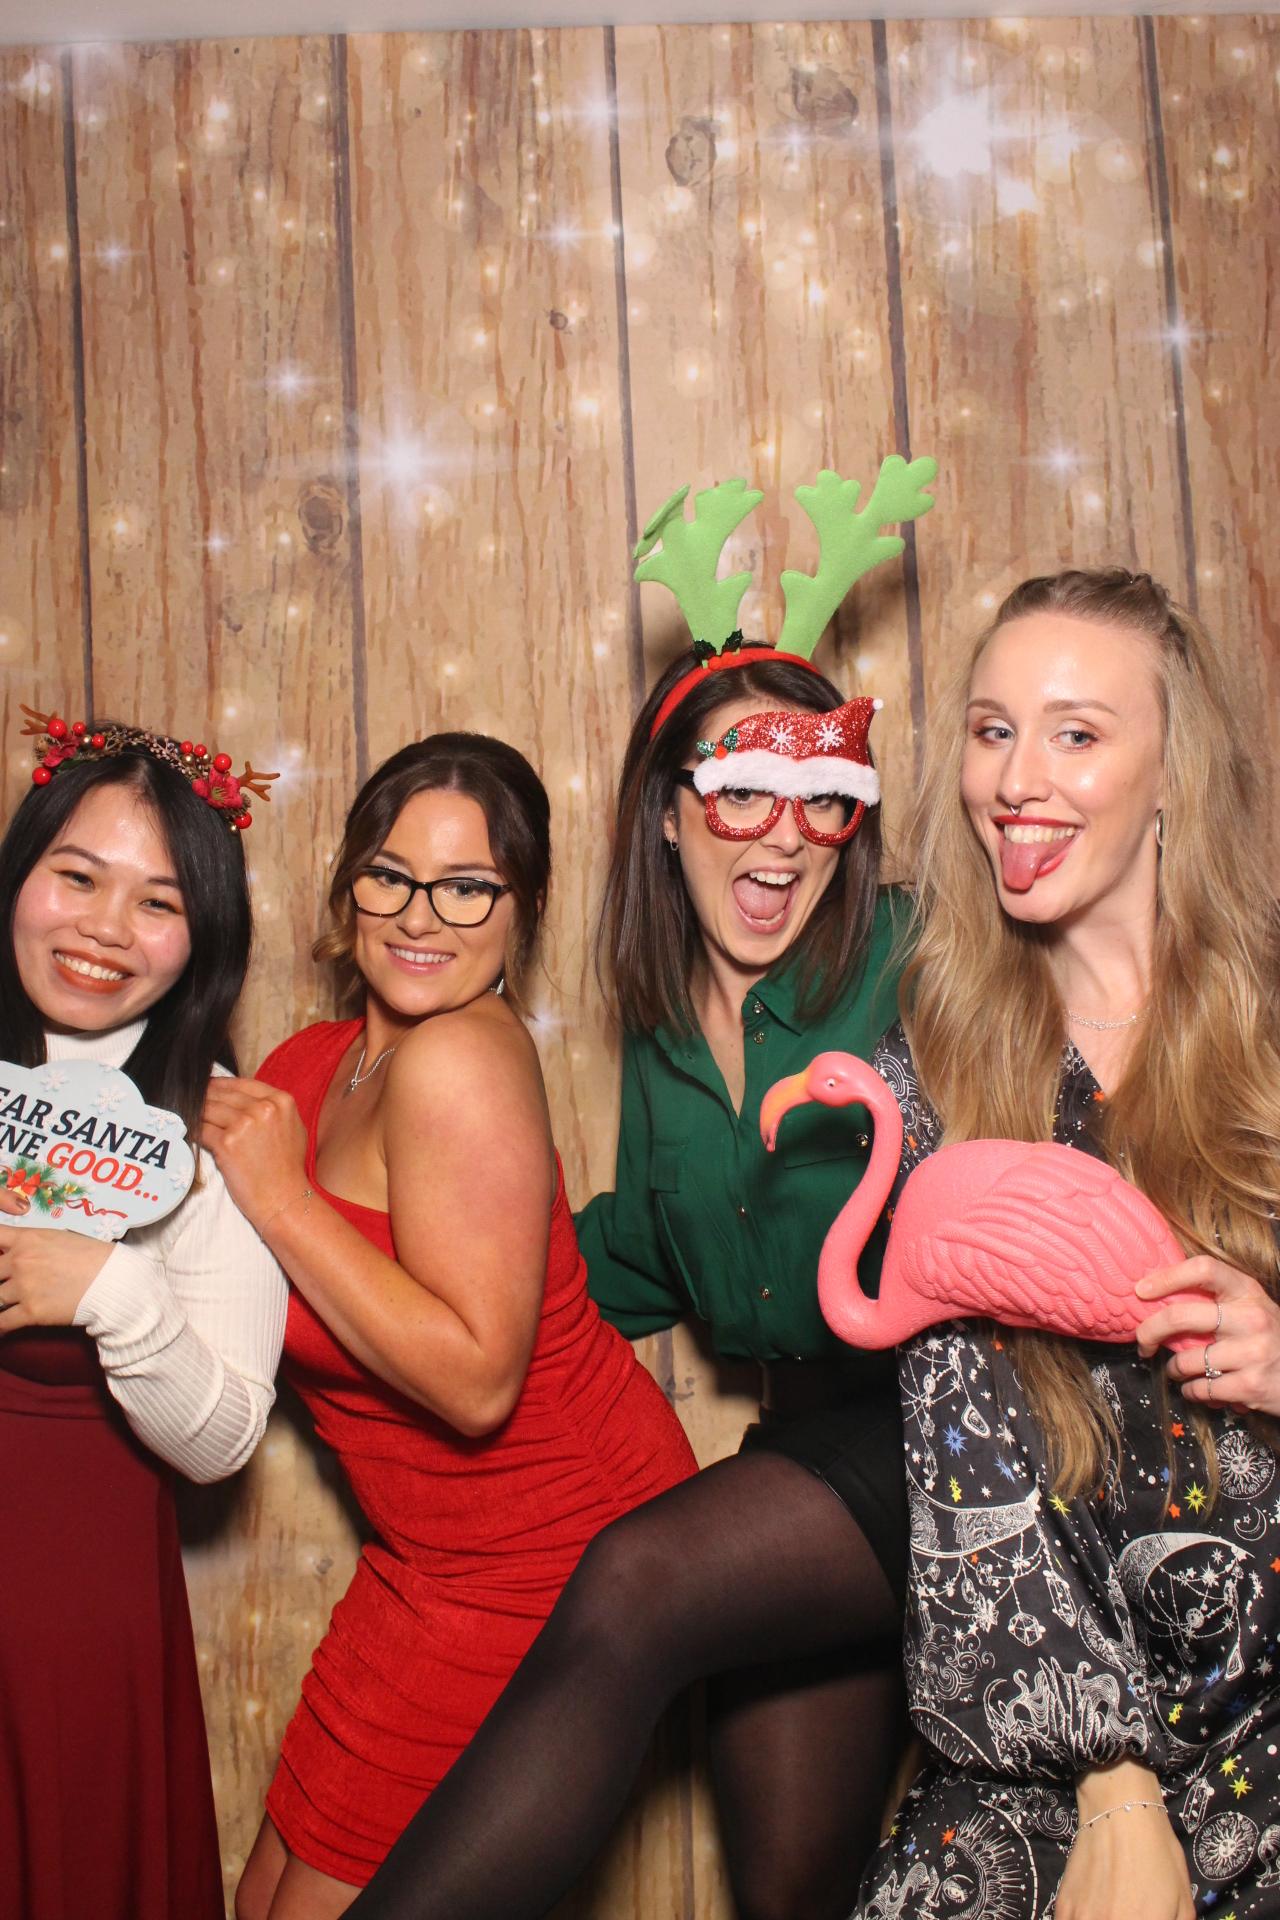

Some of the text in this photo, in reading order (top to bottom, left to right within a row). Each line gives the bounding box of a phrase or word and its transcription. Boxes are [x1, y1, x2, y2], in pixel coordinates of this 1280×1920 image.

[0, 1121, 159, 1202] NE GOOD...
[51, 1109, 171, 1169] SANTA
